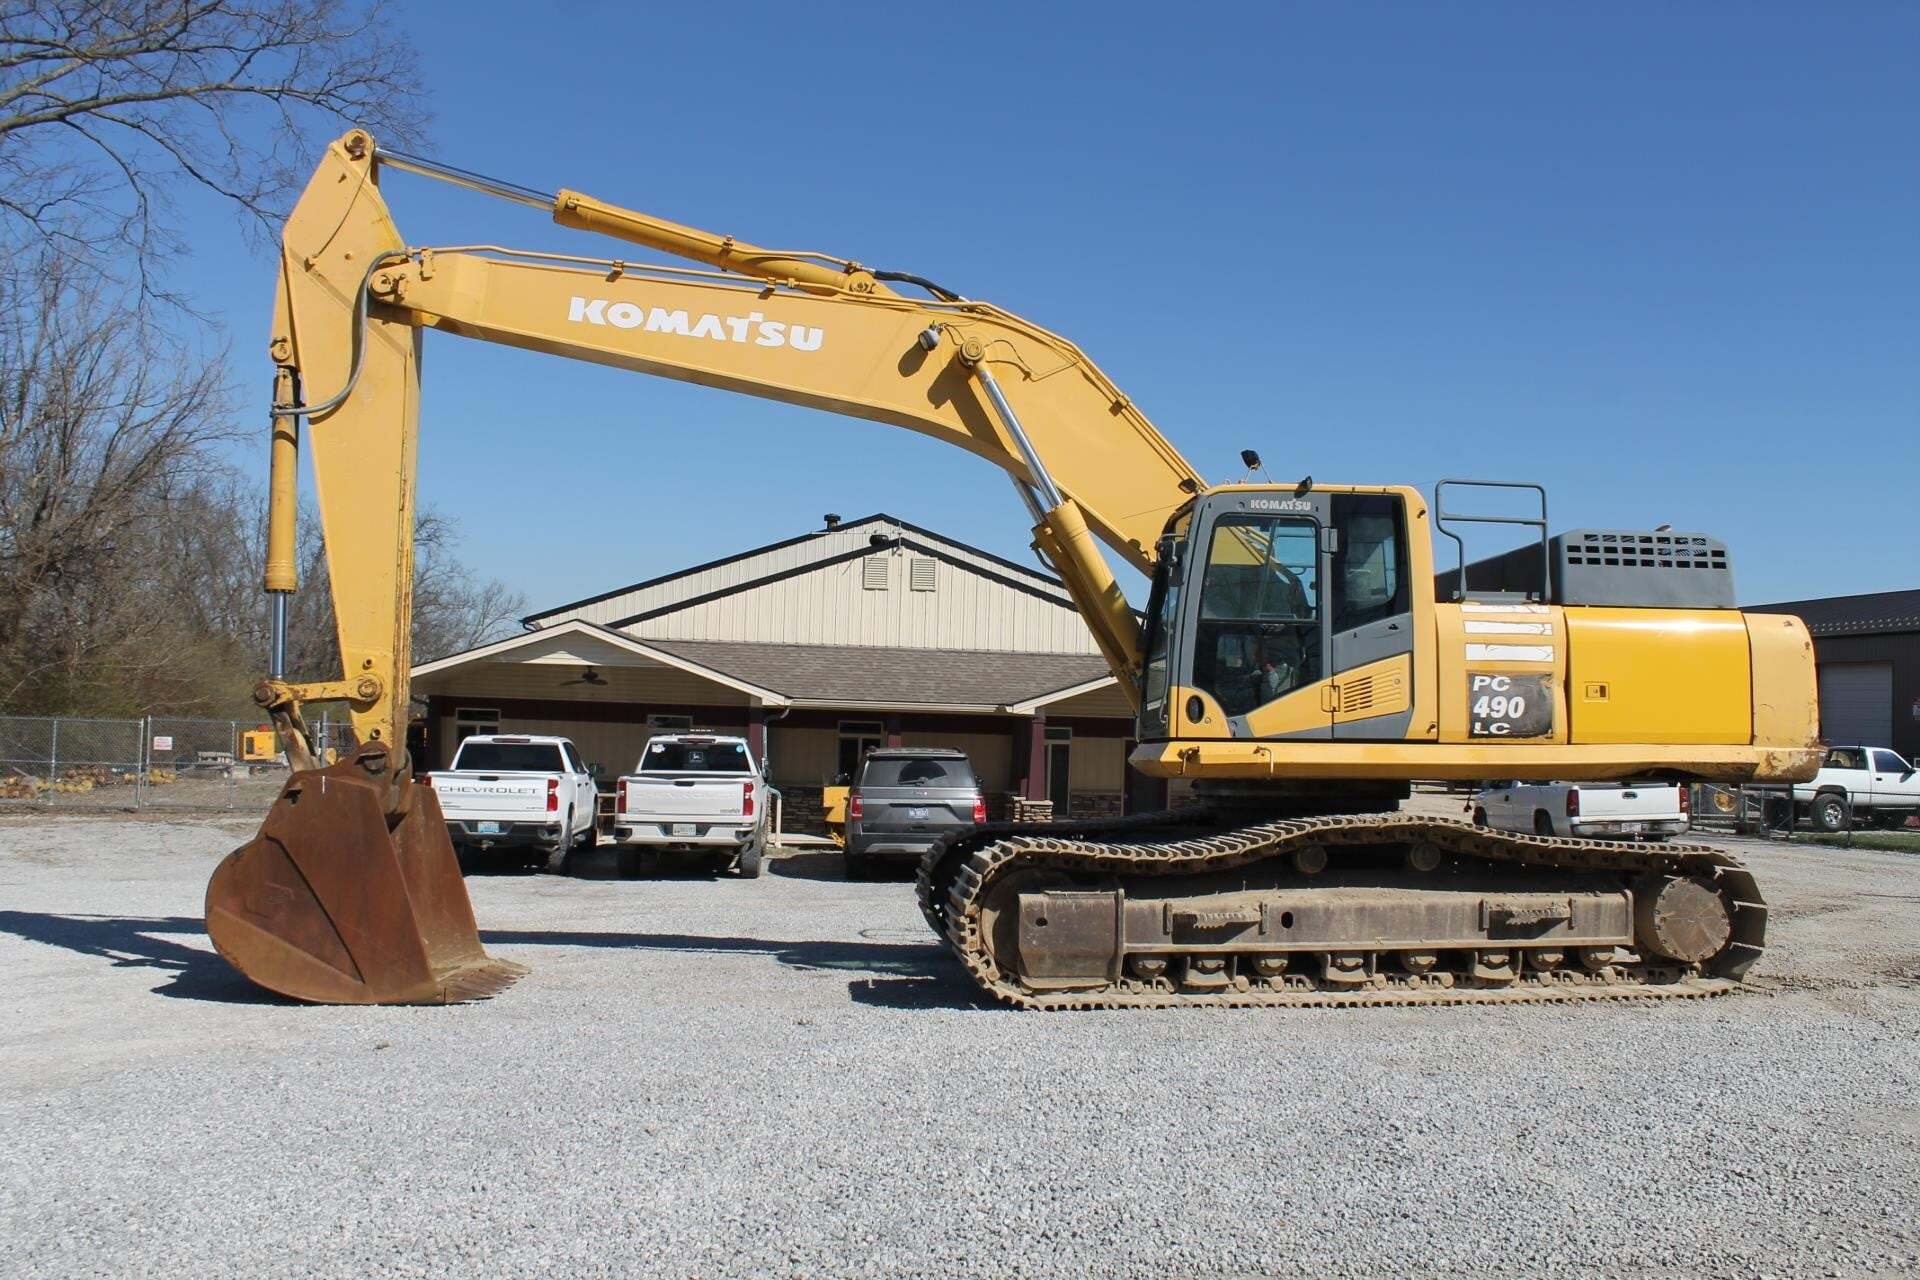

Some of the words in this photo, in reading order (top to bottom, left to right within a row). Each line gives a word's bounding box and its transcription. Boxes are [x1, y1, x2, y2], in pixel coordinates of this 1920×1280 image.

[568, 296, 824, 351] KOMATSU
[1251, 499, 1311, 511] KOMATSU
[1472, 676, 1512, 691] PC
[1473, 696, 1525, 719] 490
[1473, 722, 1511, 735] LC
[438, 786, 538, 795] CHEVROLET
